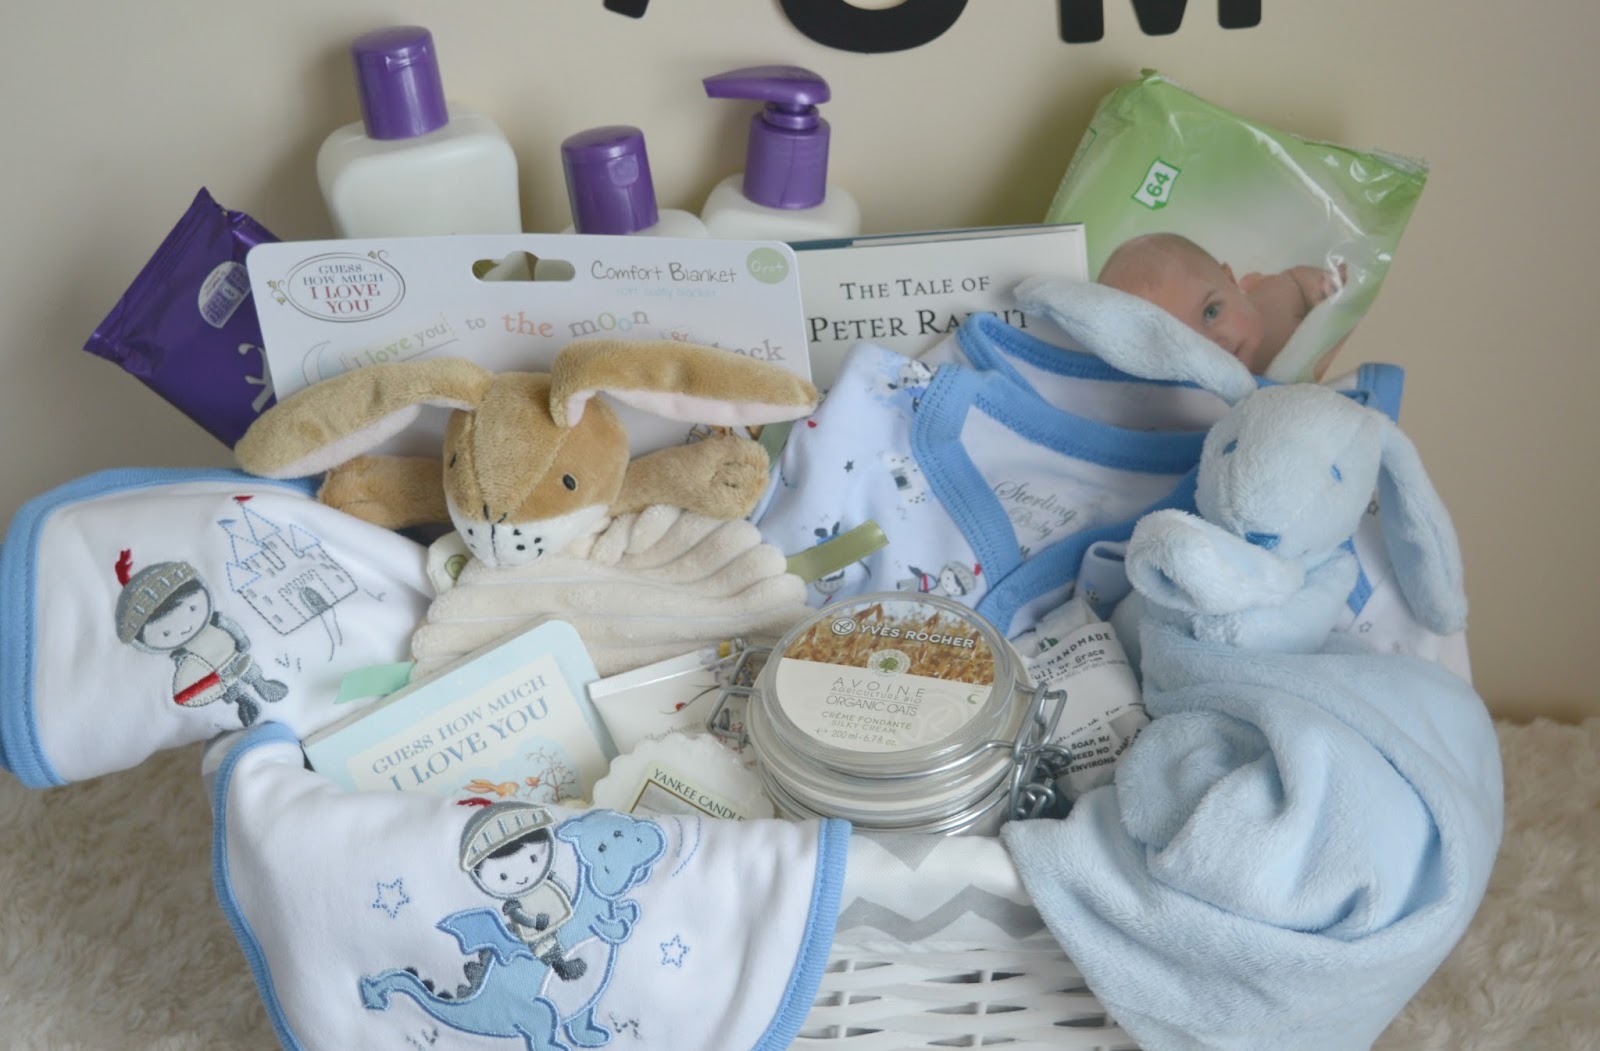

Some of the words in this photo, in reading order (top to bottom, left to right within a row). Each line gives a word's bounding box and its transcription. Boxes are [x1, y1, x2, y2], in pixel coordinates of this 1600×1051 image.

[1146, 172, 1170, 197] 64
[303, 275, 337, 286] HOW
[341, 273, 385, 284] MUCH
[318, 264, 363, 274] GUESS
[591, 260, 662, 280] Comfort
[668, 261, 737, 283] Blanket
[310, 286, 318, 300] I
[325, 284, 381, 300] LOVE
[840, 282, 890, 300] THE
[896, 278, 955, 297] TALE
[325, 299, 371, 314] YOU
[808, 316, 908, 343] PETER
[915, 309, 1028, 335] RAIT
[364, 337, 413, 365] love
[465, 317, 487, 331] to
[502, 312, 555, 338] the
[993, 481, 1077, 526] Sterling
[860, 625, 900, 638] YVES
[905, 630, 975, 648] ROCHER
[1047, 632, 1112, 665] HANDMADE
[1075, 649, 1105, 663] Grace
[831, 686, 900, 701] AGRICULTURE
[904, 696, 922, 704] BIO
[832, 677, 926, 698] AVOINE
[826, 695, 884, 711] ORGANIC
[887, 704, 918, 717] OATS
[372, 734, 434, 774] GUESS
[438, 706, 483, 742] HOW
[487, 675, 546, 713] MUCH
[832, 719, 859, 729] SILKY
[862, 723, 896, 735] CREAM
[858, 715, 912, 730] FONDANTE
[389, 774, 403, 792] I
[410, 732, 488, 785] LOVE
[489, 696, 549, 741] YOU
[831, 730, 847, 739] 200
[654, 769, 697, 799] YANKEE
